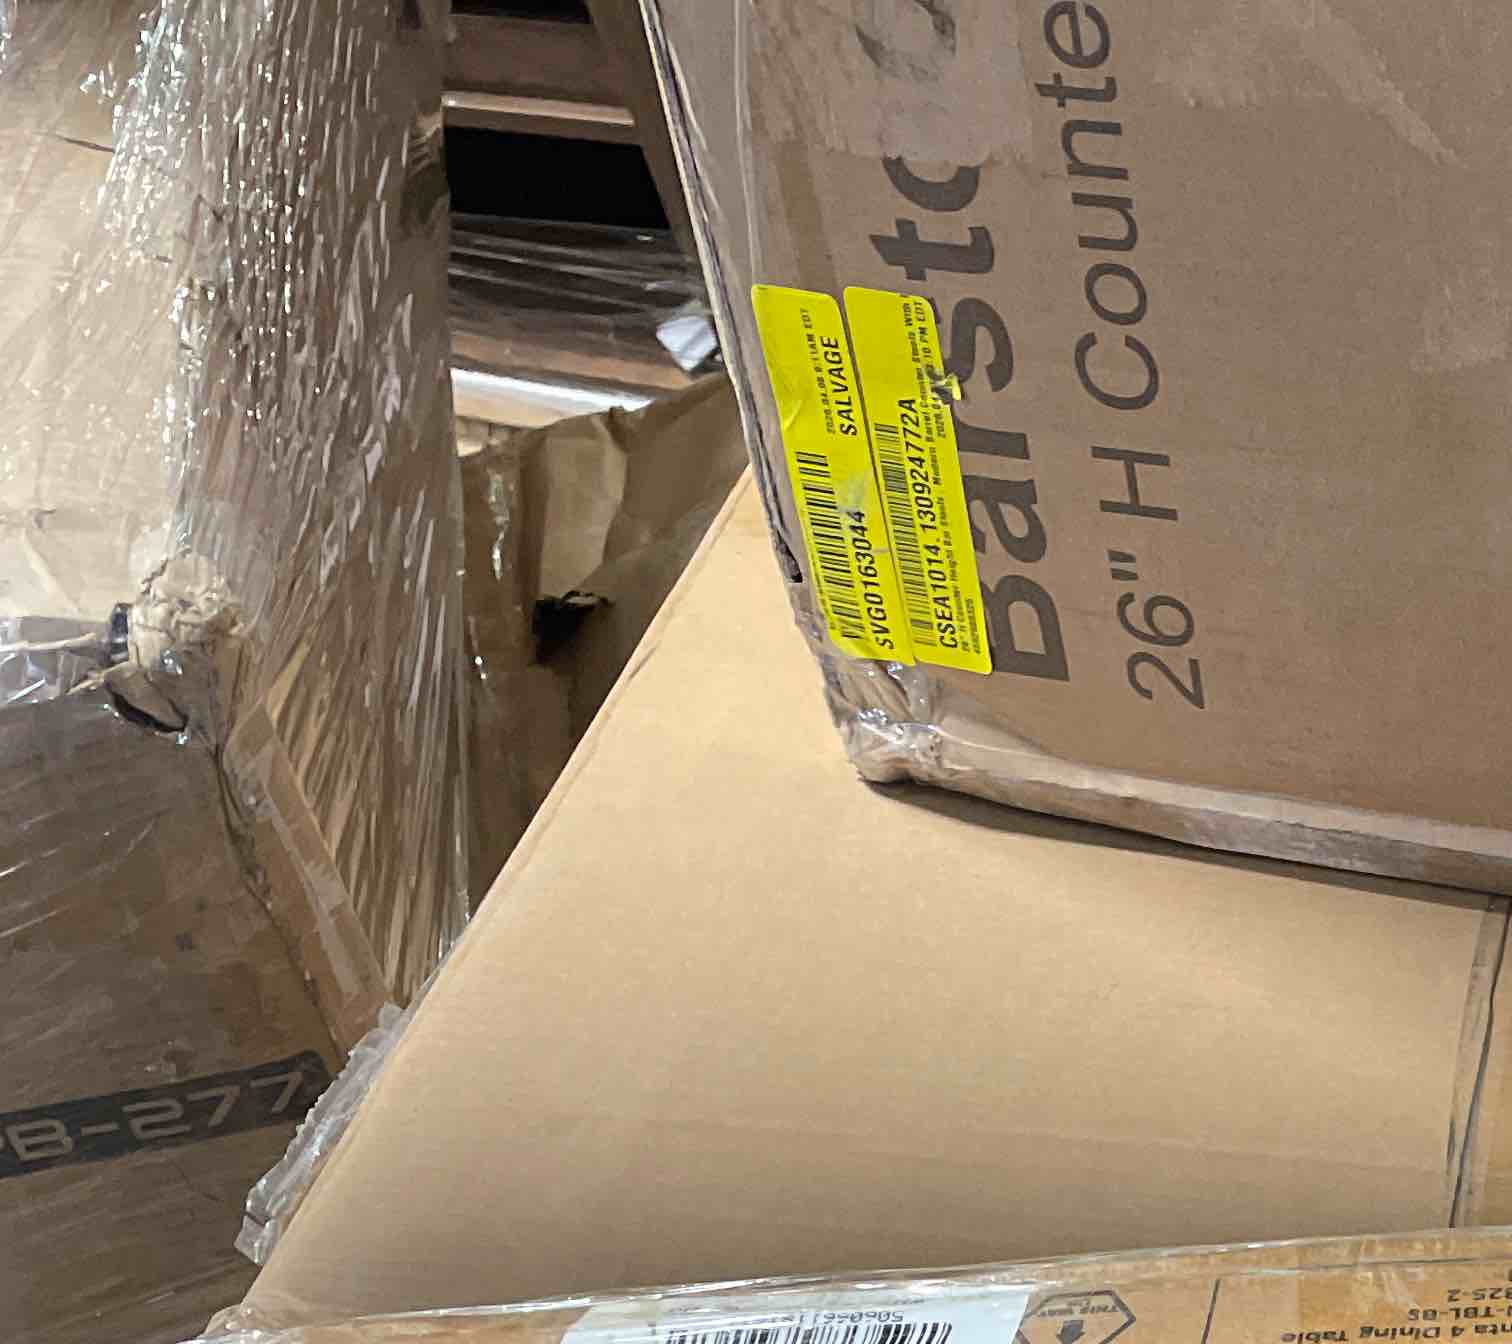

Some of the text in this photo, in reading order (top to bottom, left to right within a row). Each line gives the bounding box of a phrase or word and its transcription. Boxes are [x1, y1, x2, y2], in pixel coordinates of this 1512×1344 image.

[824, 334, 858, 438] SALVAGE
[1091, 446, 1179, 521] H
[855, 508, 895, 651] SVG0163044
[1107, 549, 1205, 710] 26"
[0, 1070, 304, 1163] B-277
